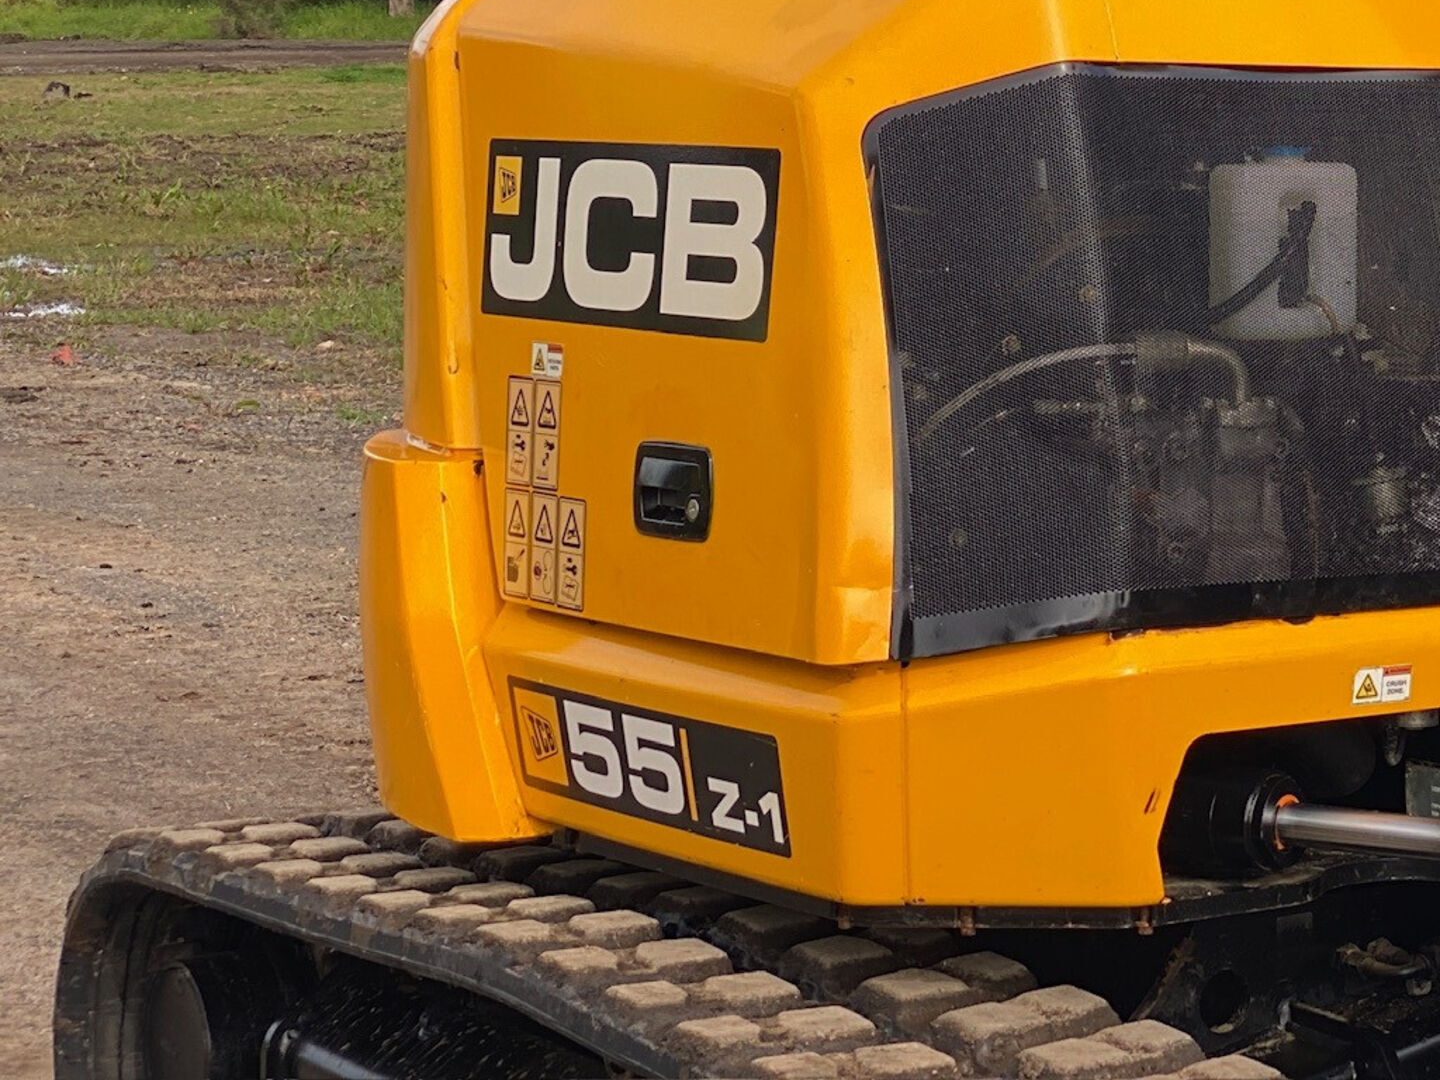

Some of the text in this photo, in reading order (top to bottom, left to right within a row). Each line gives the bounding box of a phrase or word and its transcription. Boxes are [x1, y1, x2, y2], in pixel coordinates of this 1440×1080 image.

[501, 170, 517, 199] JCB
[489, 156, 768, 321] JCB
[529, 717, 556, 754] JCB
[563, 699, 785, 845] 55 Z-1
